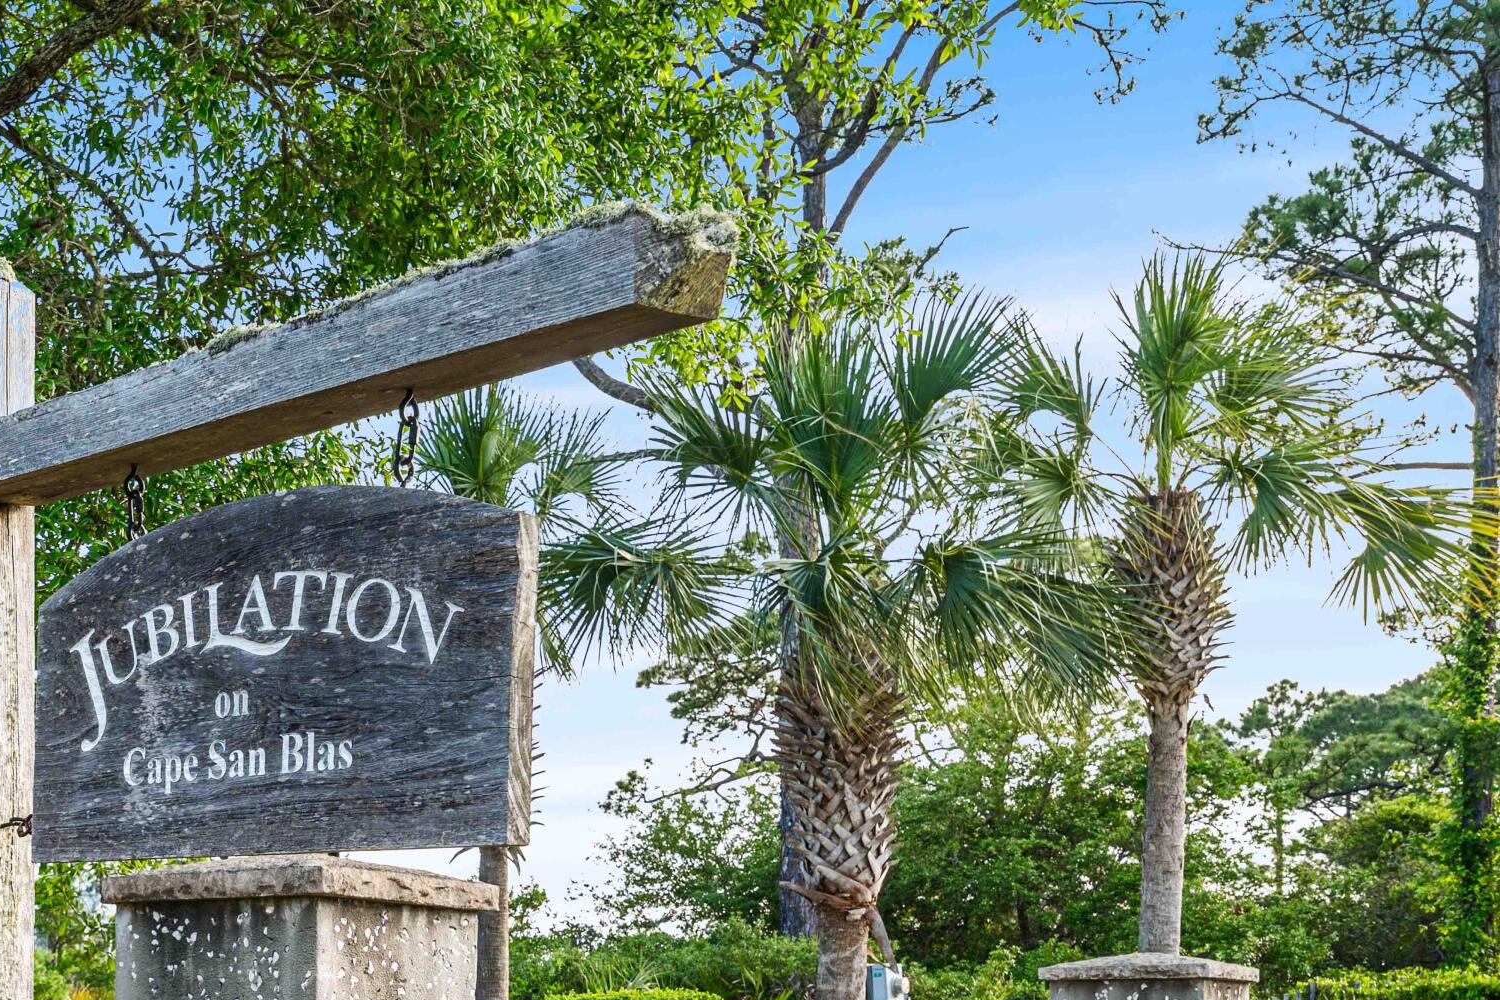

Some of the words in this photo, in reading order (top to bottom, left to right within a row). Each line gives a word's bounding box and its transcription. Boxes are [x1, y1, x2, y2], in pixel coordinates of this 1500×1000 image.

[69, 570, 465, 752] JUBILATION
[214, 688, 250, 719] on
[123, 745, 199, 795] Cape
[207, 738, 267, 781] San
[279, 731, 354, 775] Blas
